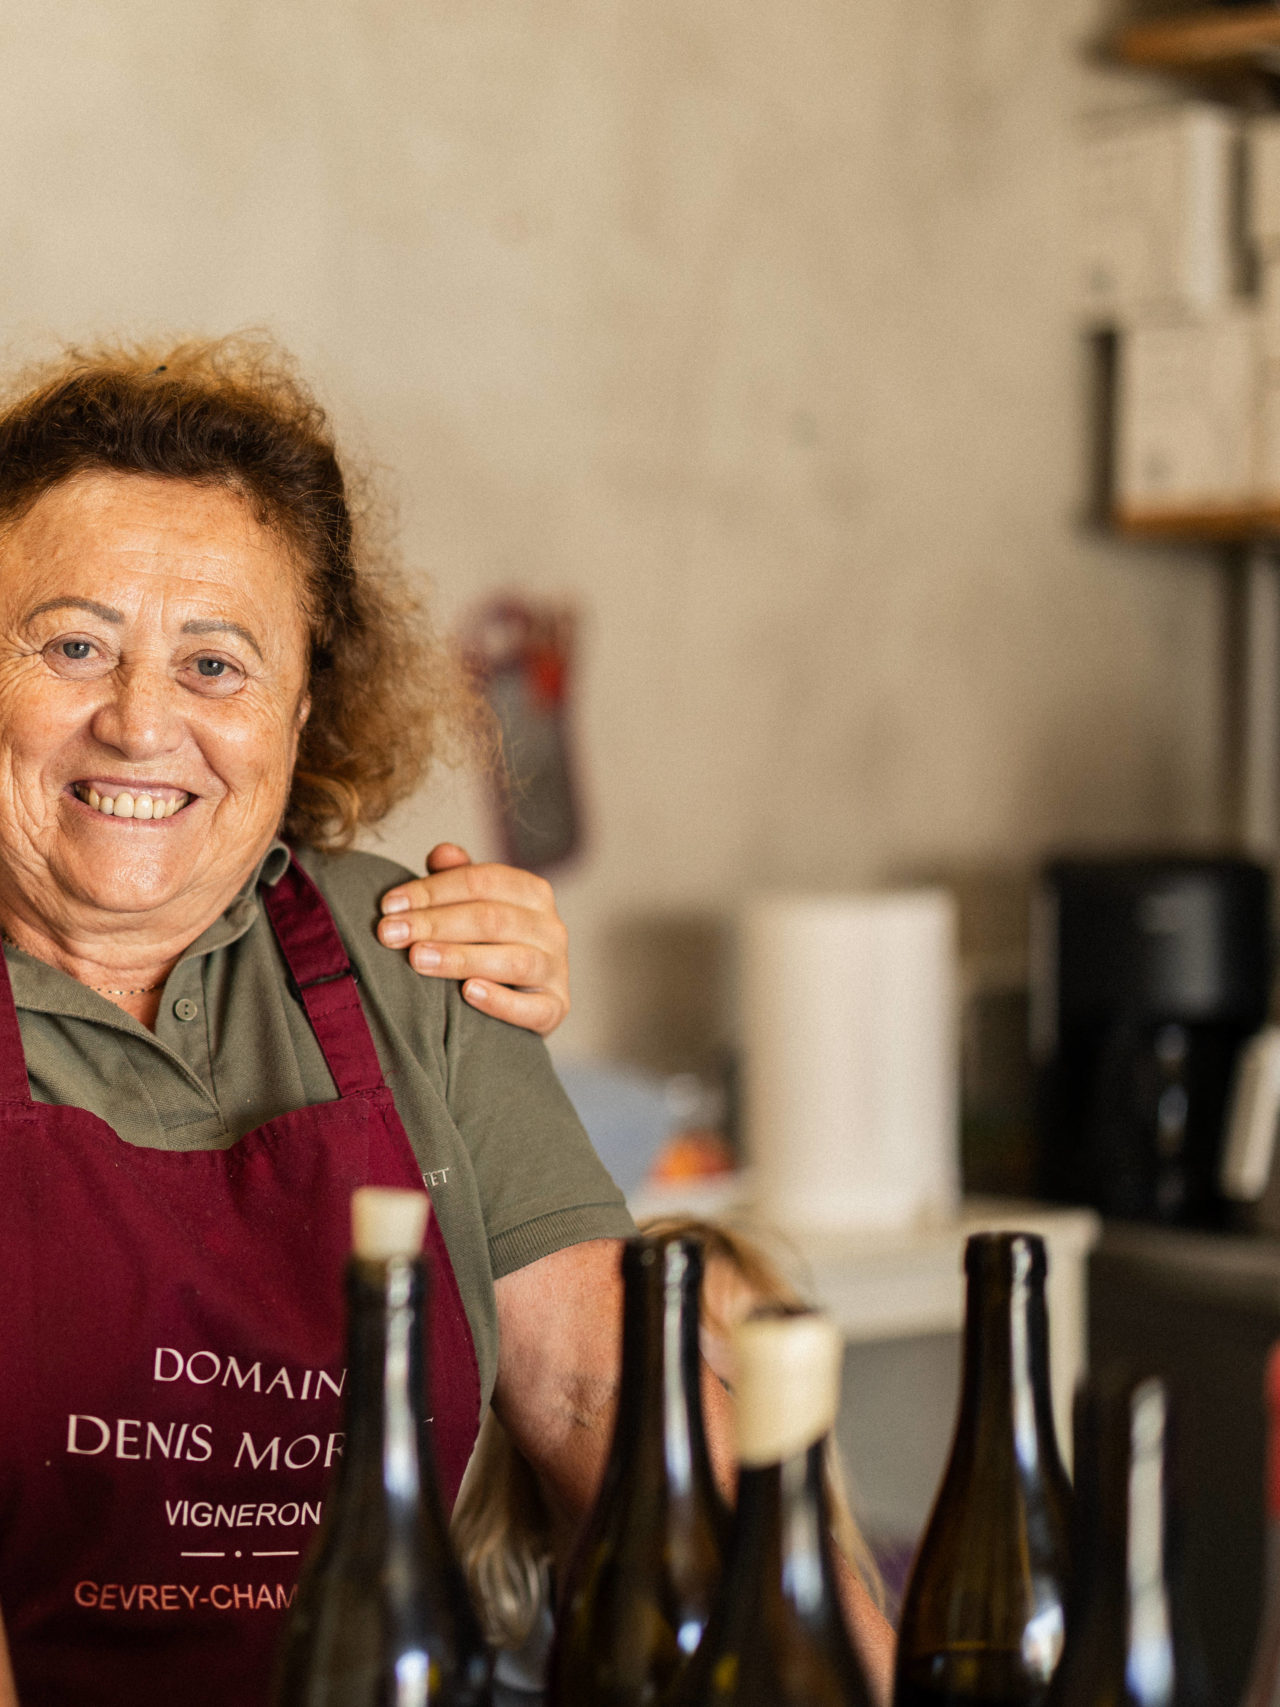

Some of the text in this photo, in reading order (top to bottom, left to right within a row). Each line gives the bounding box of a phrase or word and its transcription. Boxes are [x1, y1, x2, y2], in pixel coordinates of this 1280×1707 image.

[153, 1347, 348, 1400] DOMAIN
[66, 1413, 213, 1462] DENIS
[165, 1499, 322, 1528] VIGNERON
